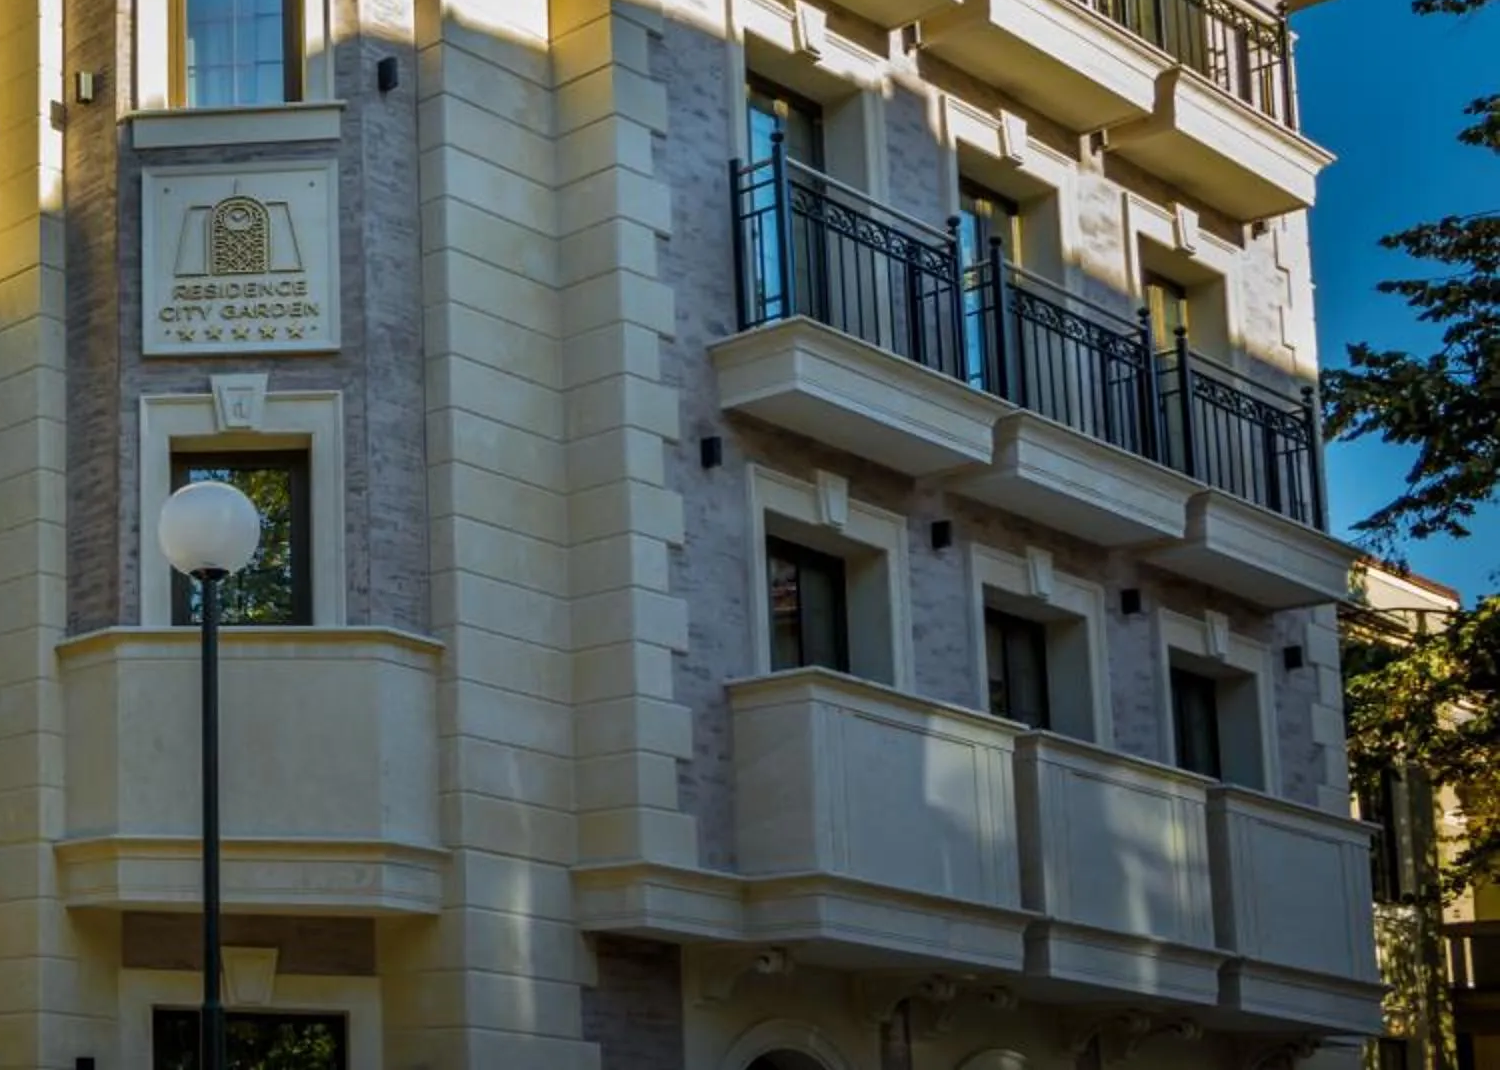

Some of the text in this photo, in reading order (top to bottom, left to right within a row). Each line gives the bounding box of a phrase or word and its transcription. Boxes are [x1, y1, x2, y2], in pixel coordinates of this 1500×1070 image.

[173, 281, 308, 300] RESIDENCE
[160, 301, 320, 322] CITY GARDEN
